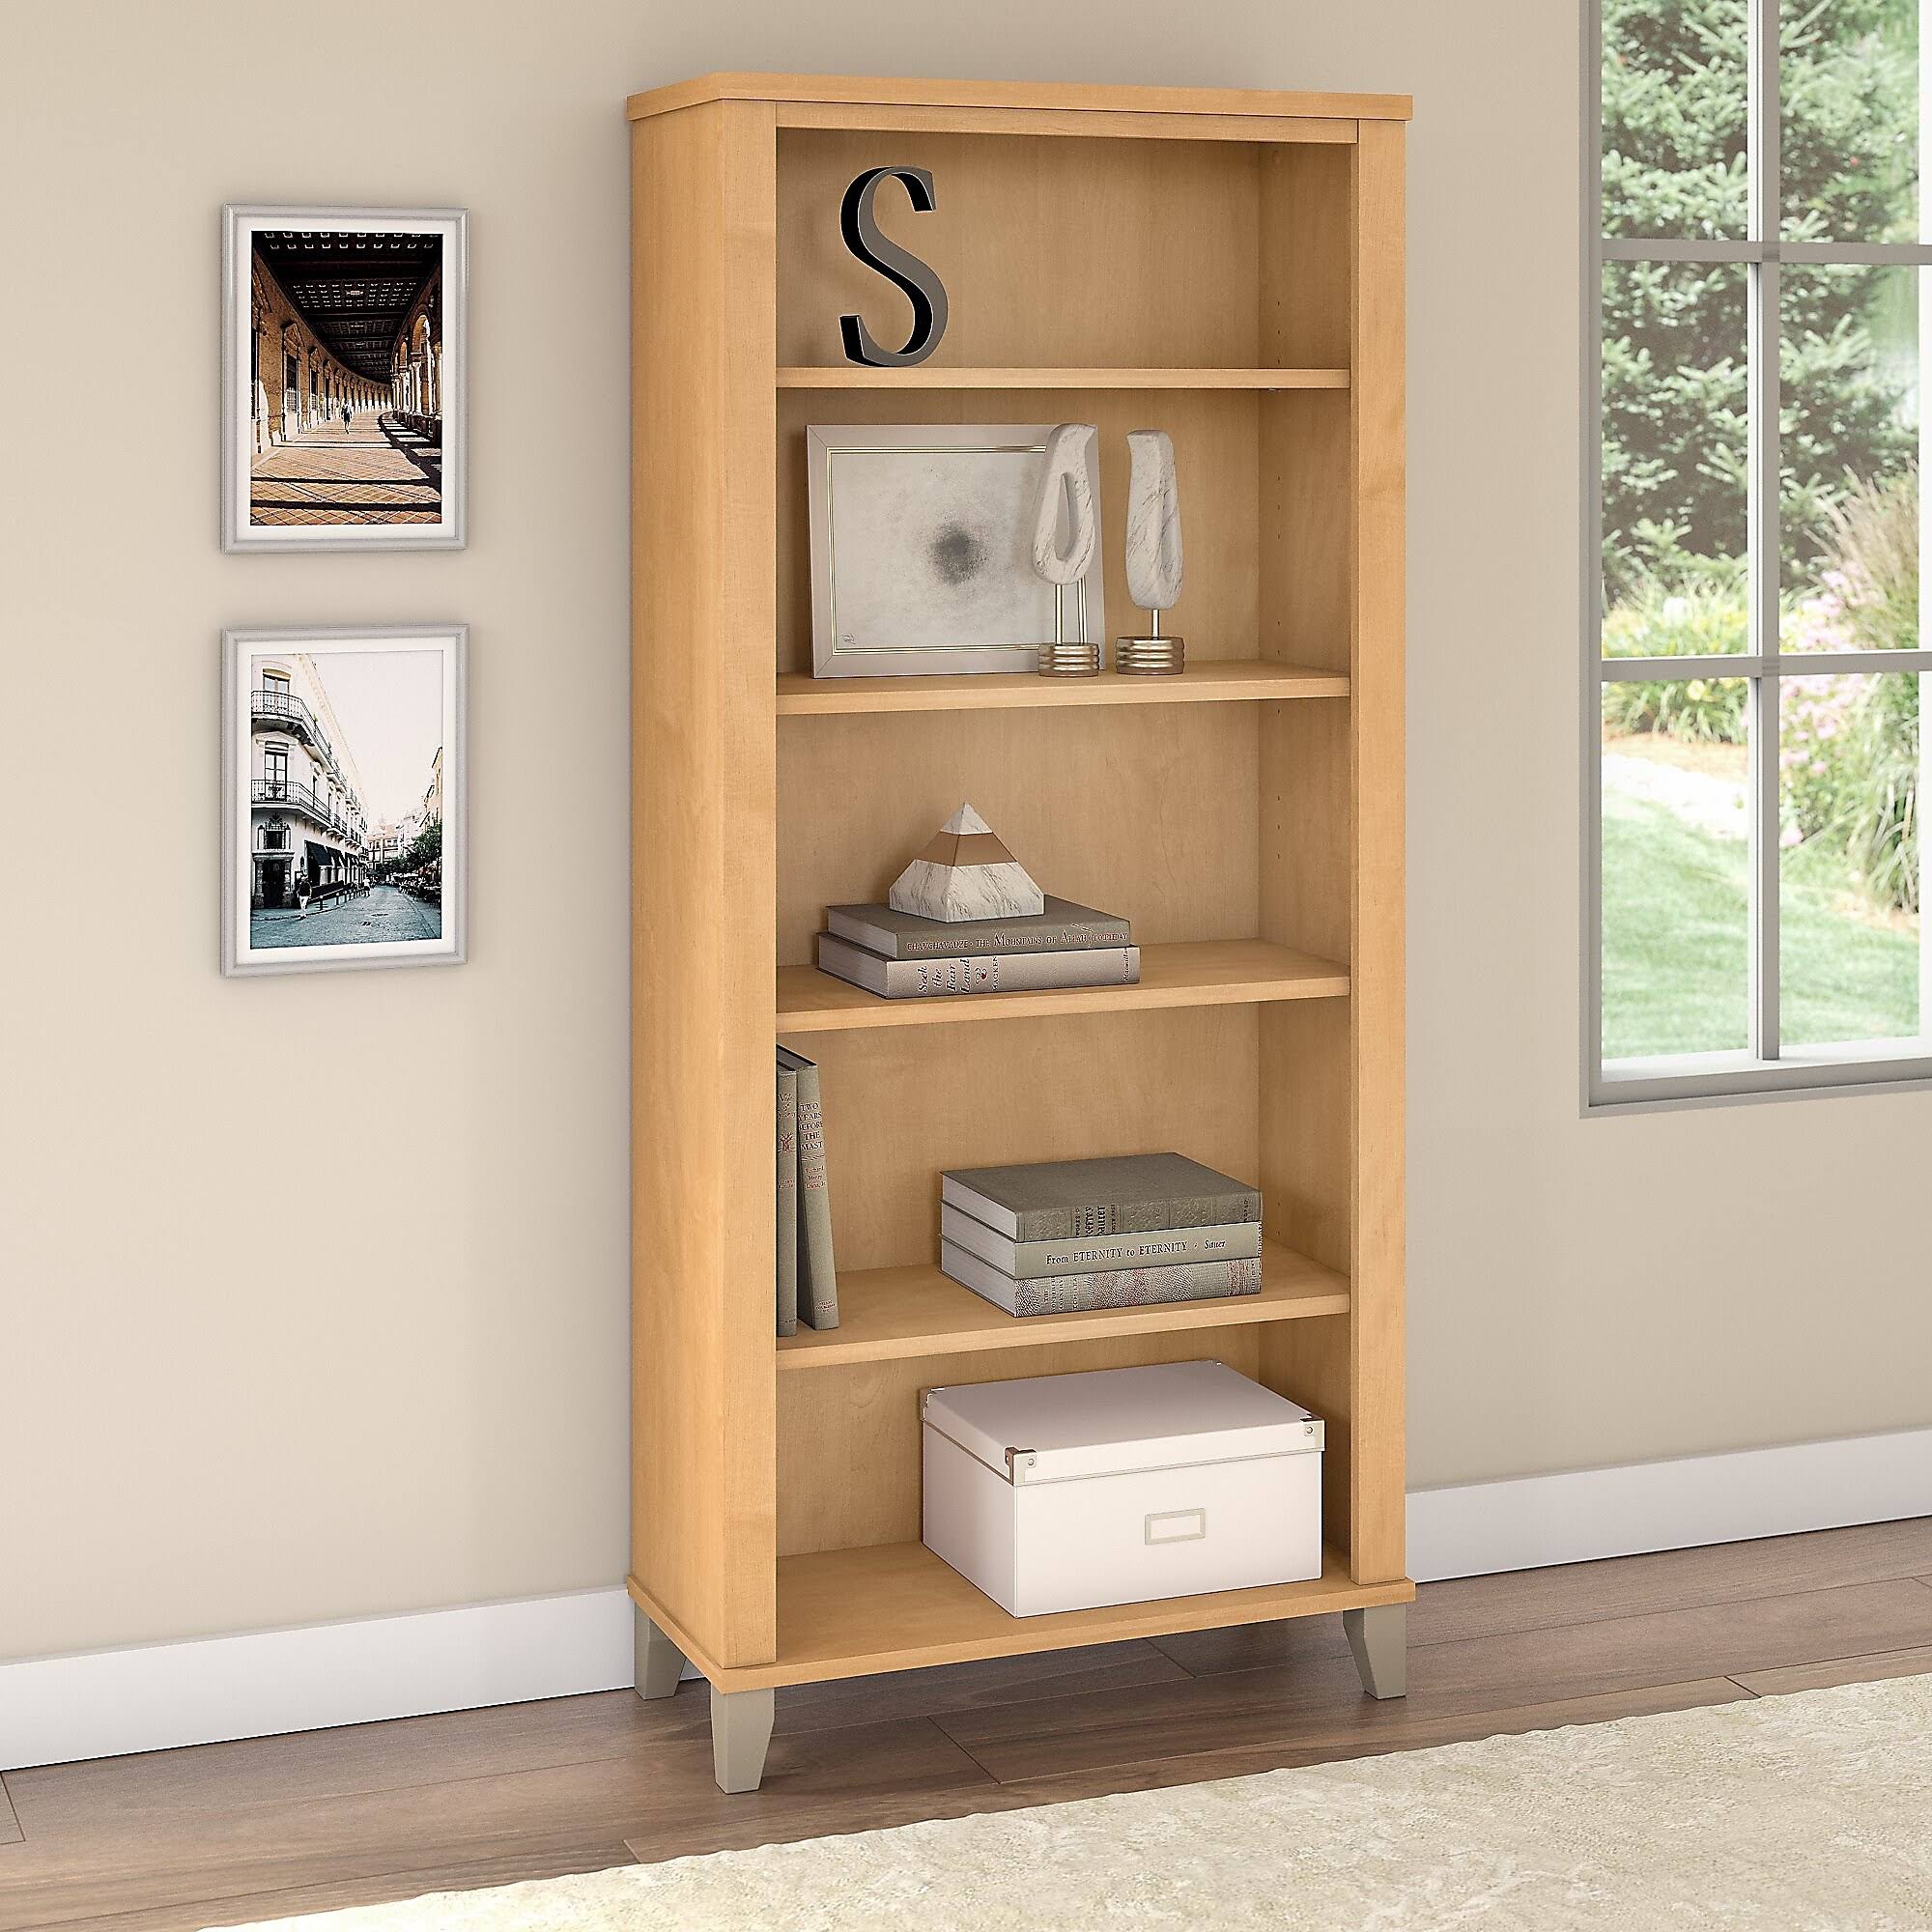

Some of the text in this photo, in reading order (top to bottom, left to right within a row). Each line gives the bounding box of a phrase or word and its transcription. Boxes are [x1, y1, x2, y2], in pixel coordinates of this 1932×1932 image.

[838, 165, 950, 368] S
[976, 939, 991, 948] THE
[917, 965, 927, 993] Seek
[931, 968, 942, 988] the
[946, 964, 956, 992] Fair
[960, 958, 970, 993] Land
[798, 1111, 822, 1122] YEARS
[800, 1103, 819, 1112] TWO
[803, 1130, 821, 1141] THE
[801, 1141, 823, 1151] MAST
[1046, 1254, 1069, 1265] From
[1073, 1246, 1123, 1262] ETERNITY
[1139, 1241, 1188, 1256] ETERNITY
